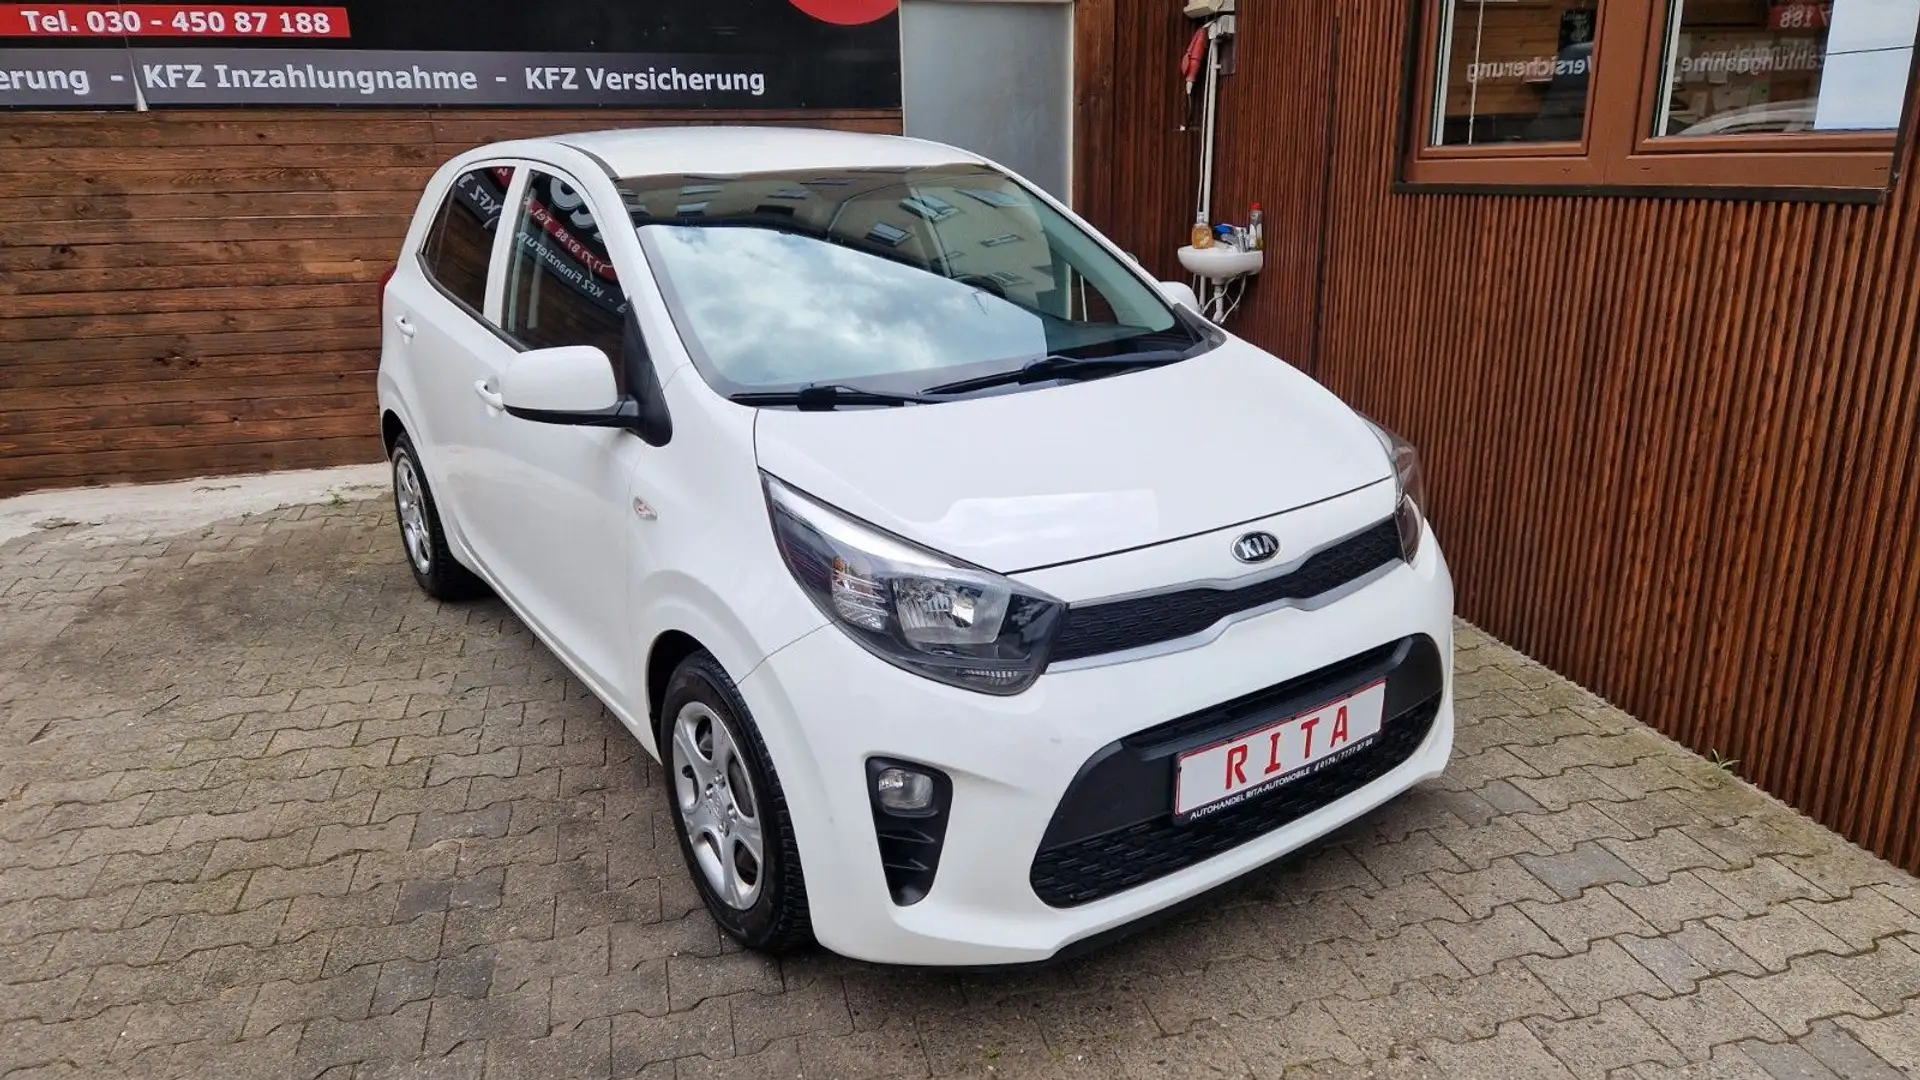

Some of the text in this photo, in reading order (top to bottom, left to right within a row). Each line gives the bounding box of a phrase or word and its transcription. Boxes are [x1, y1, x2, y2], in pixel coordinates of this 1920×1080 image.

[21, 10, 78, 32] Tel.
[86, 11, 141, 32] 030
[171, 11, 225, 32] 450
[234, 11, 267, 32] 87
[280, 12, 331, 33] 188
[143, 65, 206, 89] KFZ
[214, 64, 478, 94] Inzahlungnahme
[525, 67, 579, 89] KFZ
[586, 67, 765, 94] Versicherung
[1239, 535, 1277, 559] KIA
[1225, 704, 1349, 790] RITA
[1189, 794, 1246, 820] AUTOHANDEL
